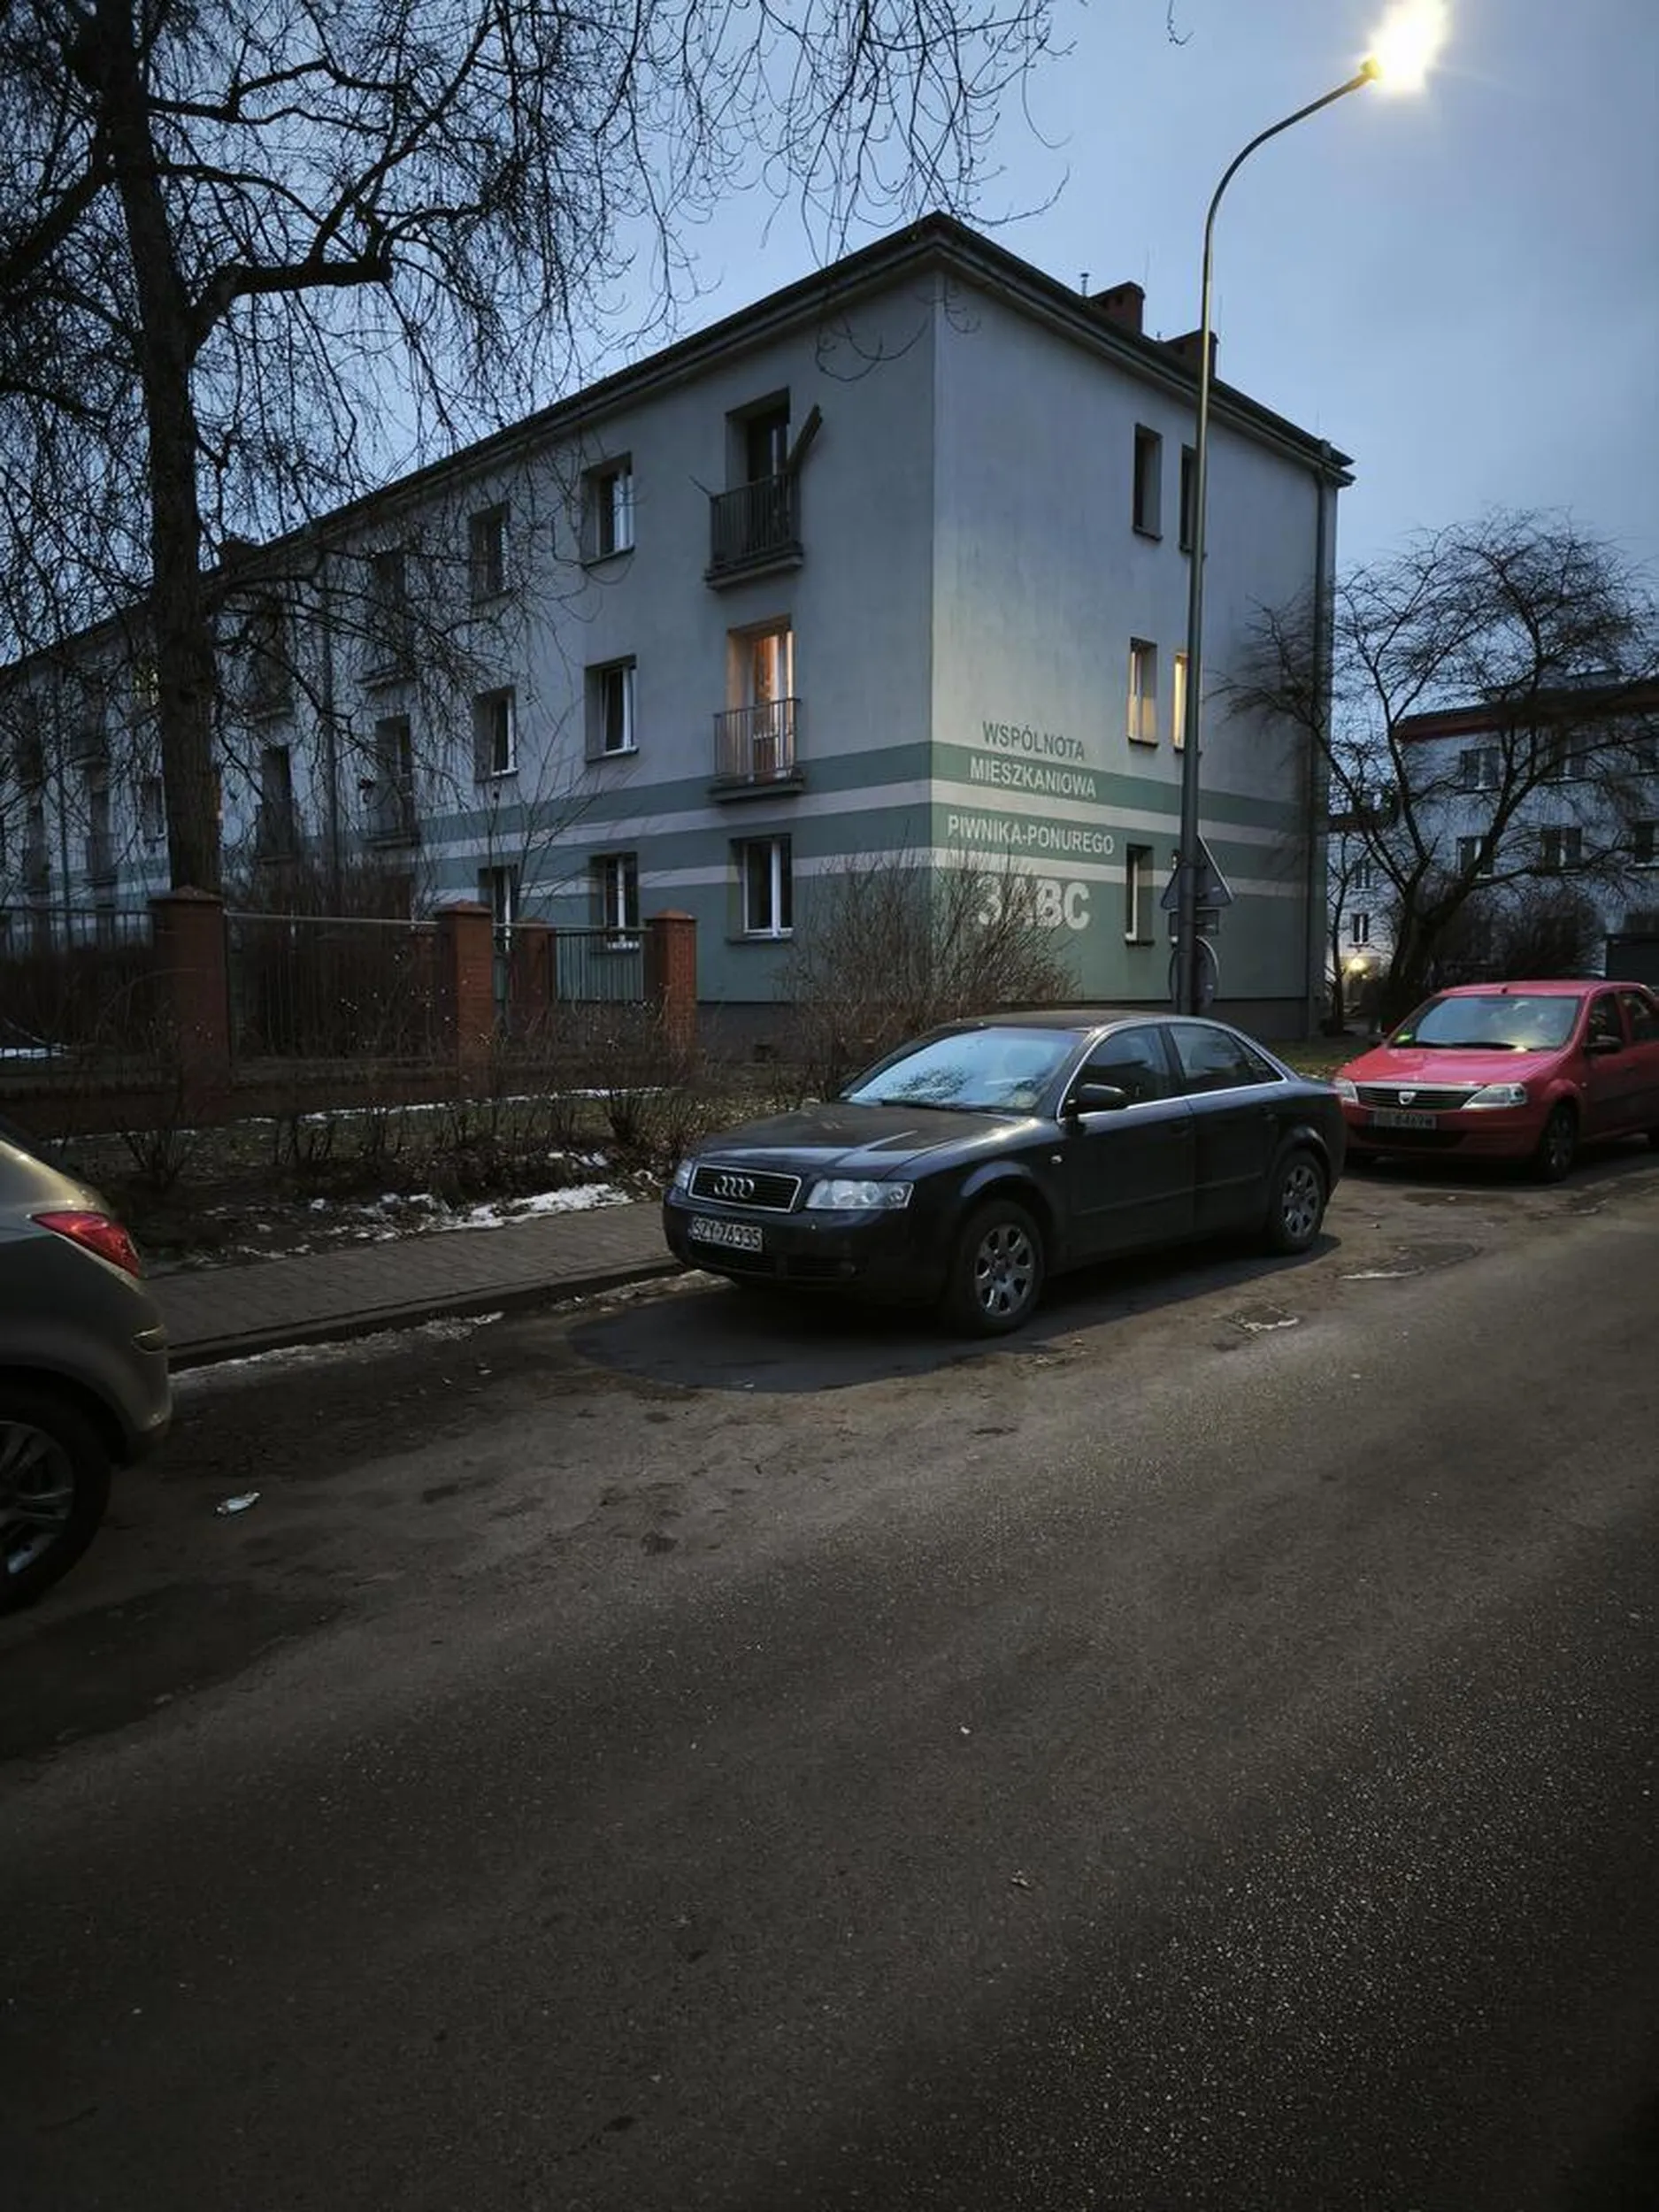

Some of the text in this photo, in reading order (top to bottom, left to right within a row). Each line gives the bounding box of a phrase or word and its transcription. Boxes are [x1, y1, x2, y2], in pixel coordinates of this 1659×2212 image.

[982, 721, 1086, 761] WSPÓLNOTA
[970, 756, 1097, 799] MIESZKANIOWA
[947, 814, 1115, 855] PIWNIKA-PONUREGO
